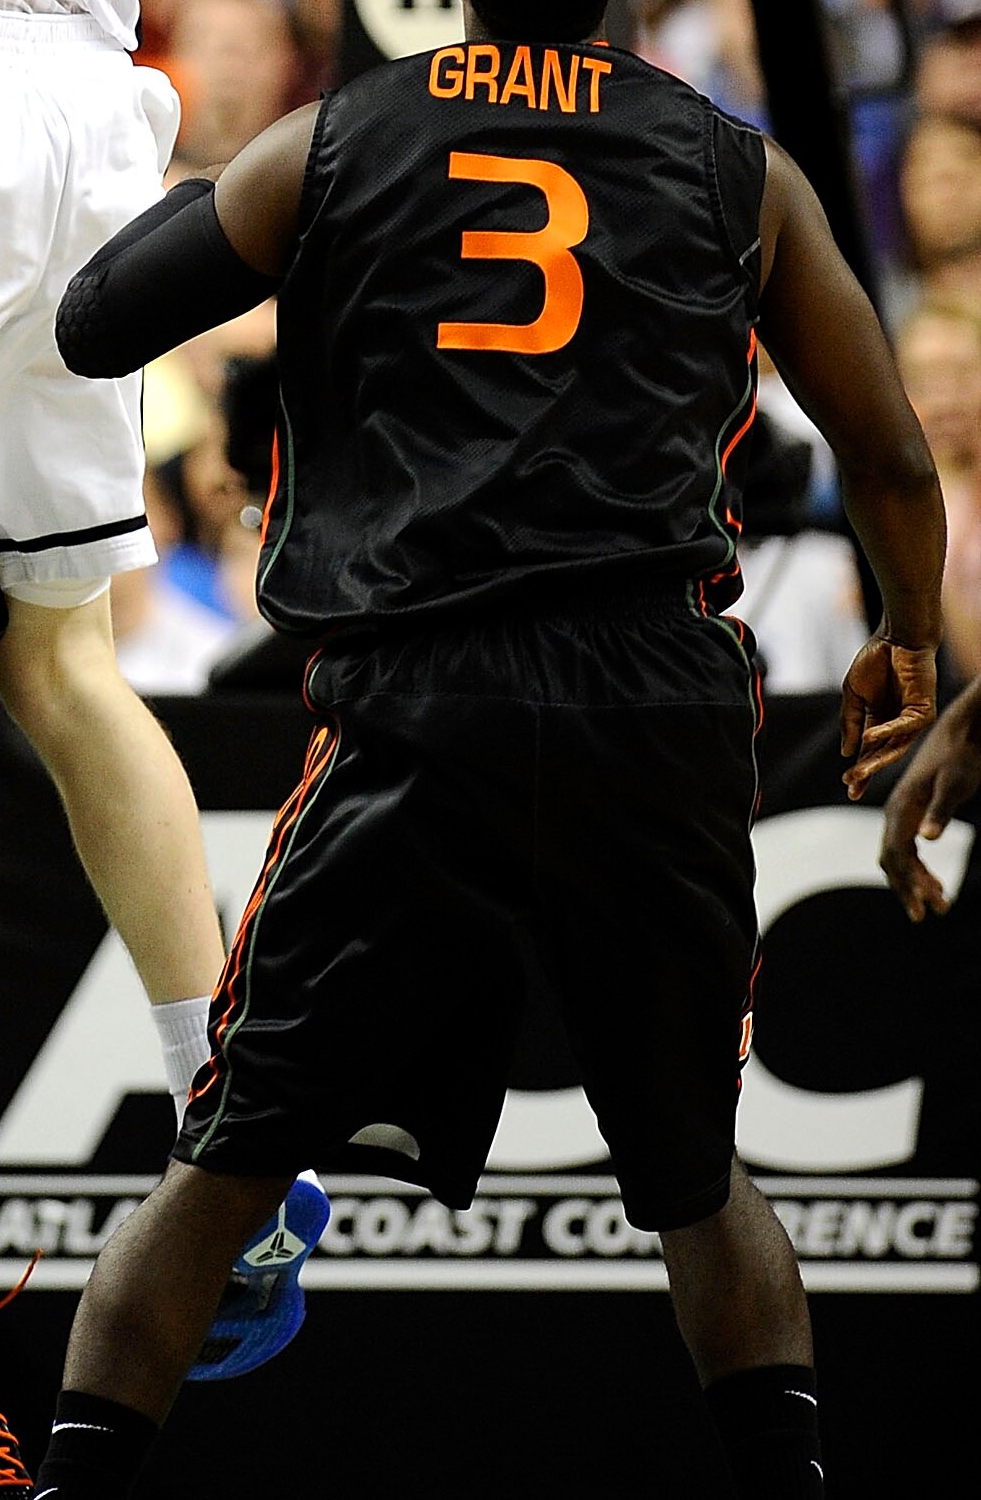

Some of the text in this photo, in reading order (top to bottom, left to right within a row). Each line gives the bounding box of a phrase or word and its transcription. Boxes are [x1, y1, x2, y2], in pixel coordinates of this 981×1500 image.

[429, 44, 612, 113] GRANT
[436, 151, 589, 354] 3
[320, 1198, 536, 1257] COAST
[542, 1198, 980, 1260] CORENCE
